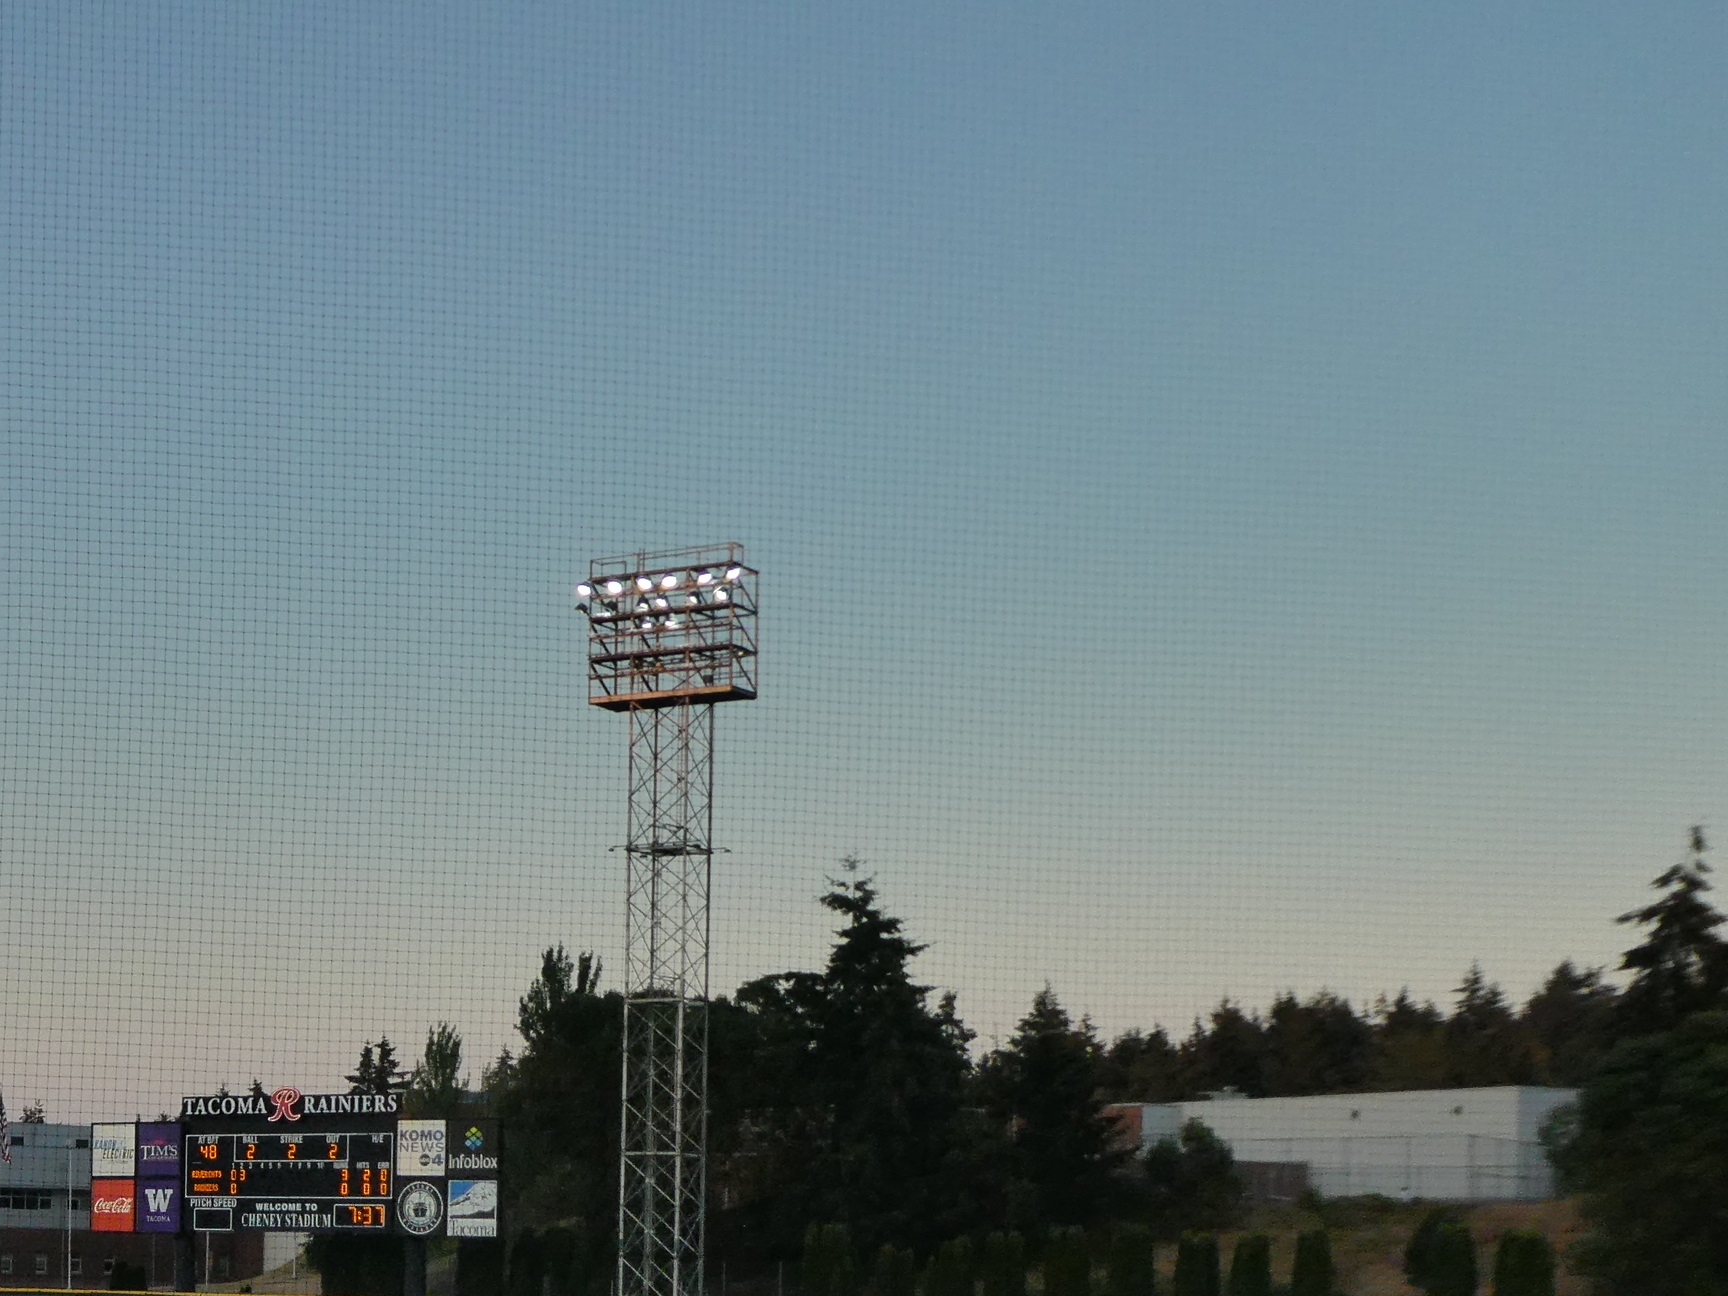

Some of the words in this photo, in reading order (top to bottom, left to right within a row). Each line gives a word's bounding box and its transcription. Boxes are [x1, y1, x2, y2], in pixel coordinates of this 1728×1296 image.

[184, 1097, 268, 1116] TACOMA
[304, 1094, 398, 1114] RAINIERS
[242, 1136, 258, 1144] BALL
[280, 1136, 303, 1144] STRIKE
[326, 1135, 340, 1143] OUT
[372, 1135, 384, 1143] H/E
[400, 1130, 444, 1142] KOMO
[140, 1145, 178, 1160] TIM'S
[200, 1144, 217, 1160] 48
[246, 1144, 255, 1160] 2
[288, 1144, 296, 1159] 2
[329, 1144, 338, 1158] 2
[400, 1142, 444, 1153] NEWS
[102, 1149, 135, 1160] ELECTRIC
[432, 1154, 444, 1166] 4
[448, 1154, 498, 1169] Infoblox
[230, 1170, 237, 1181] 0
[240, 1170, 246, 1181] 3
[342, 1169, 348, 1181] 3
[363, 1169, 370, 1181] 2
[230, 1183, 237, 1195] 0
[341, 1183, 348, 1195] 0
[380, 1183, 388, 1195] 0
[144, 1188, 174, 1212] W
[190, 1199, 212, 1208] PITCH
[213, 1200, 237, 1208] SPEED
[256, 1203, 303, 1212] WELCOME
[305, 1203, 318, 1212] TO
[241, 1213, 282, 1228] CHENEY
[284, 1213, 332, 1228] STADIUM
[348, 1206, 384, 1226] 7:37
[449, 1220, 496, 1237] Tacoma
